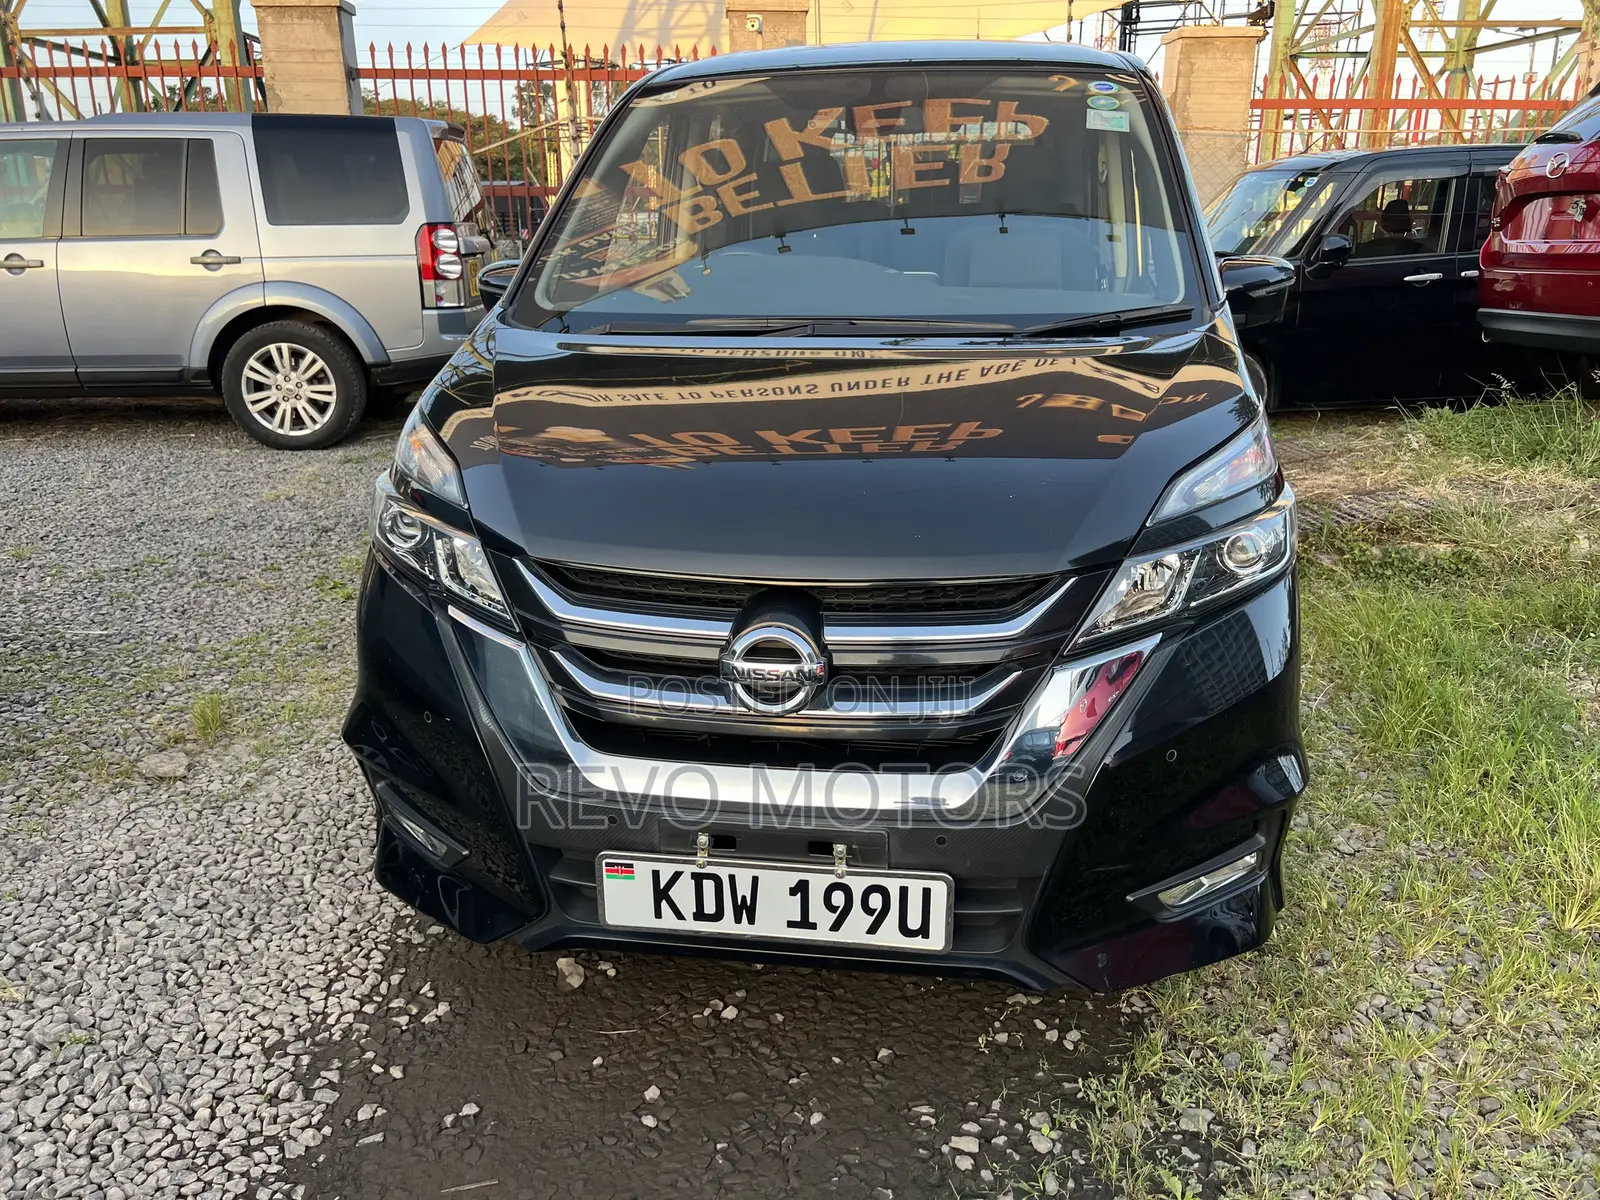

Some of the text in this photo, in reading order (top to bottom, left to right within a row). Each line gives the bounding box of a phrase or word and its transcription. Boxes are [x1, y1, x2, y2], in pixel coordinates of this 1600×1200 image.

[731, 667, 812, 682] NISSAN
[652, 869, 932, 940] KDW 199U
